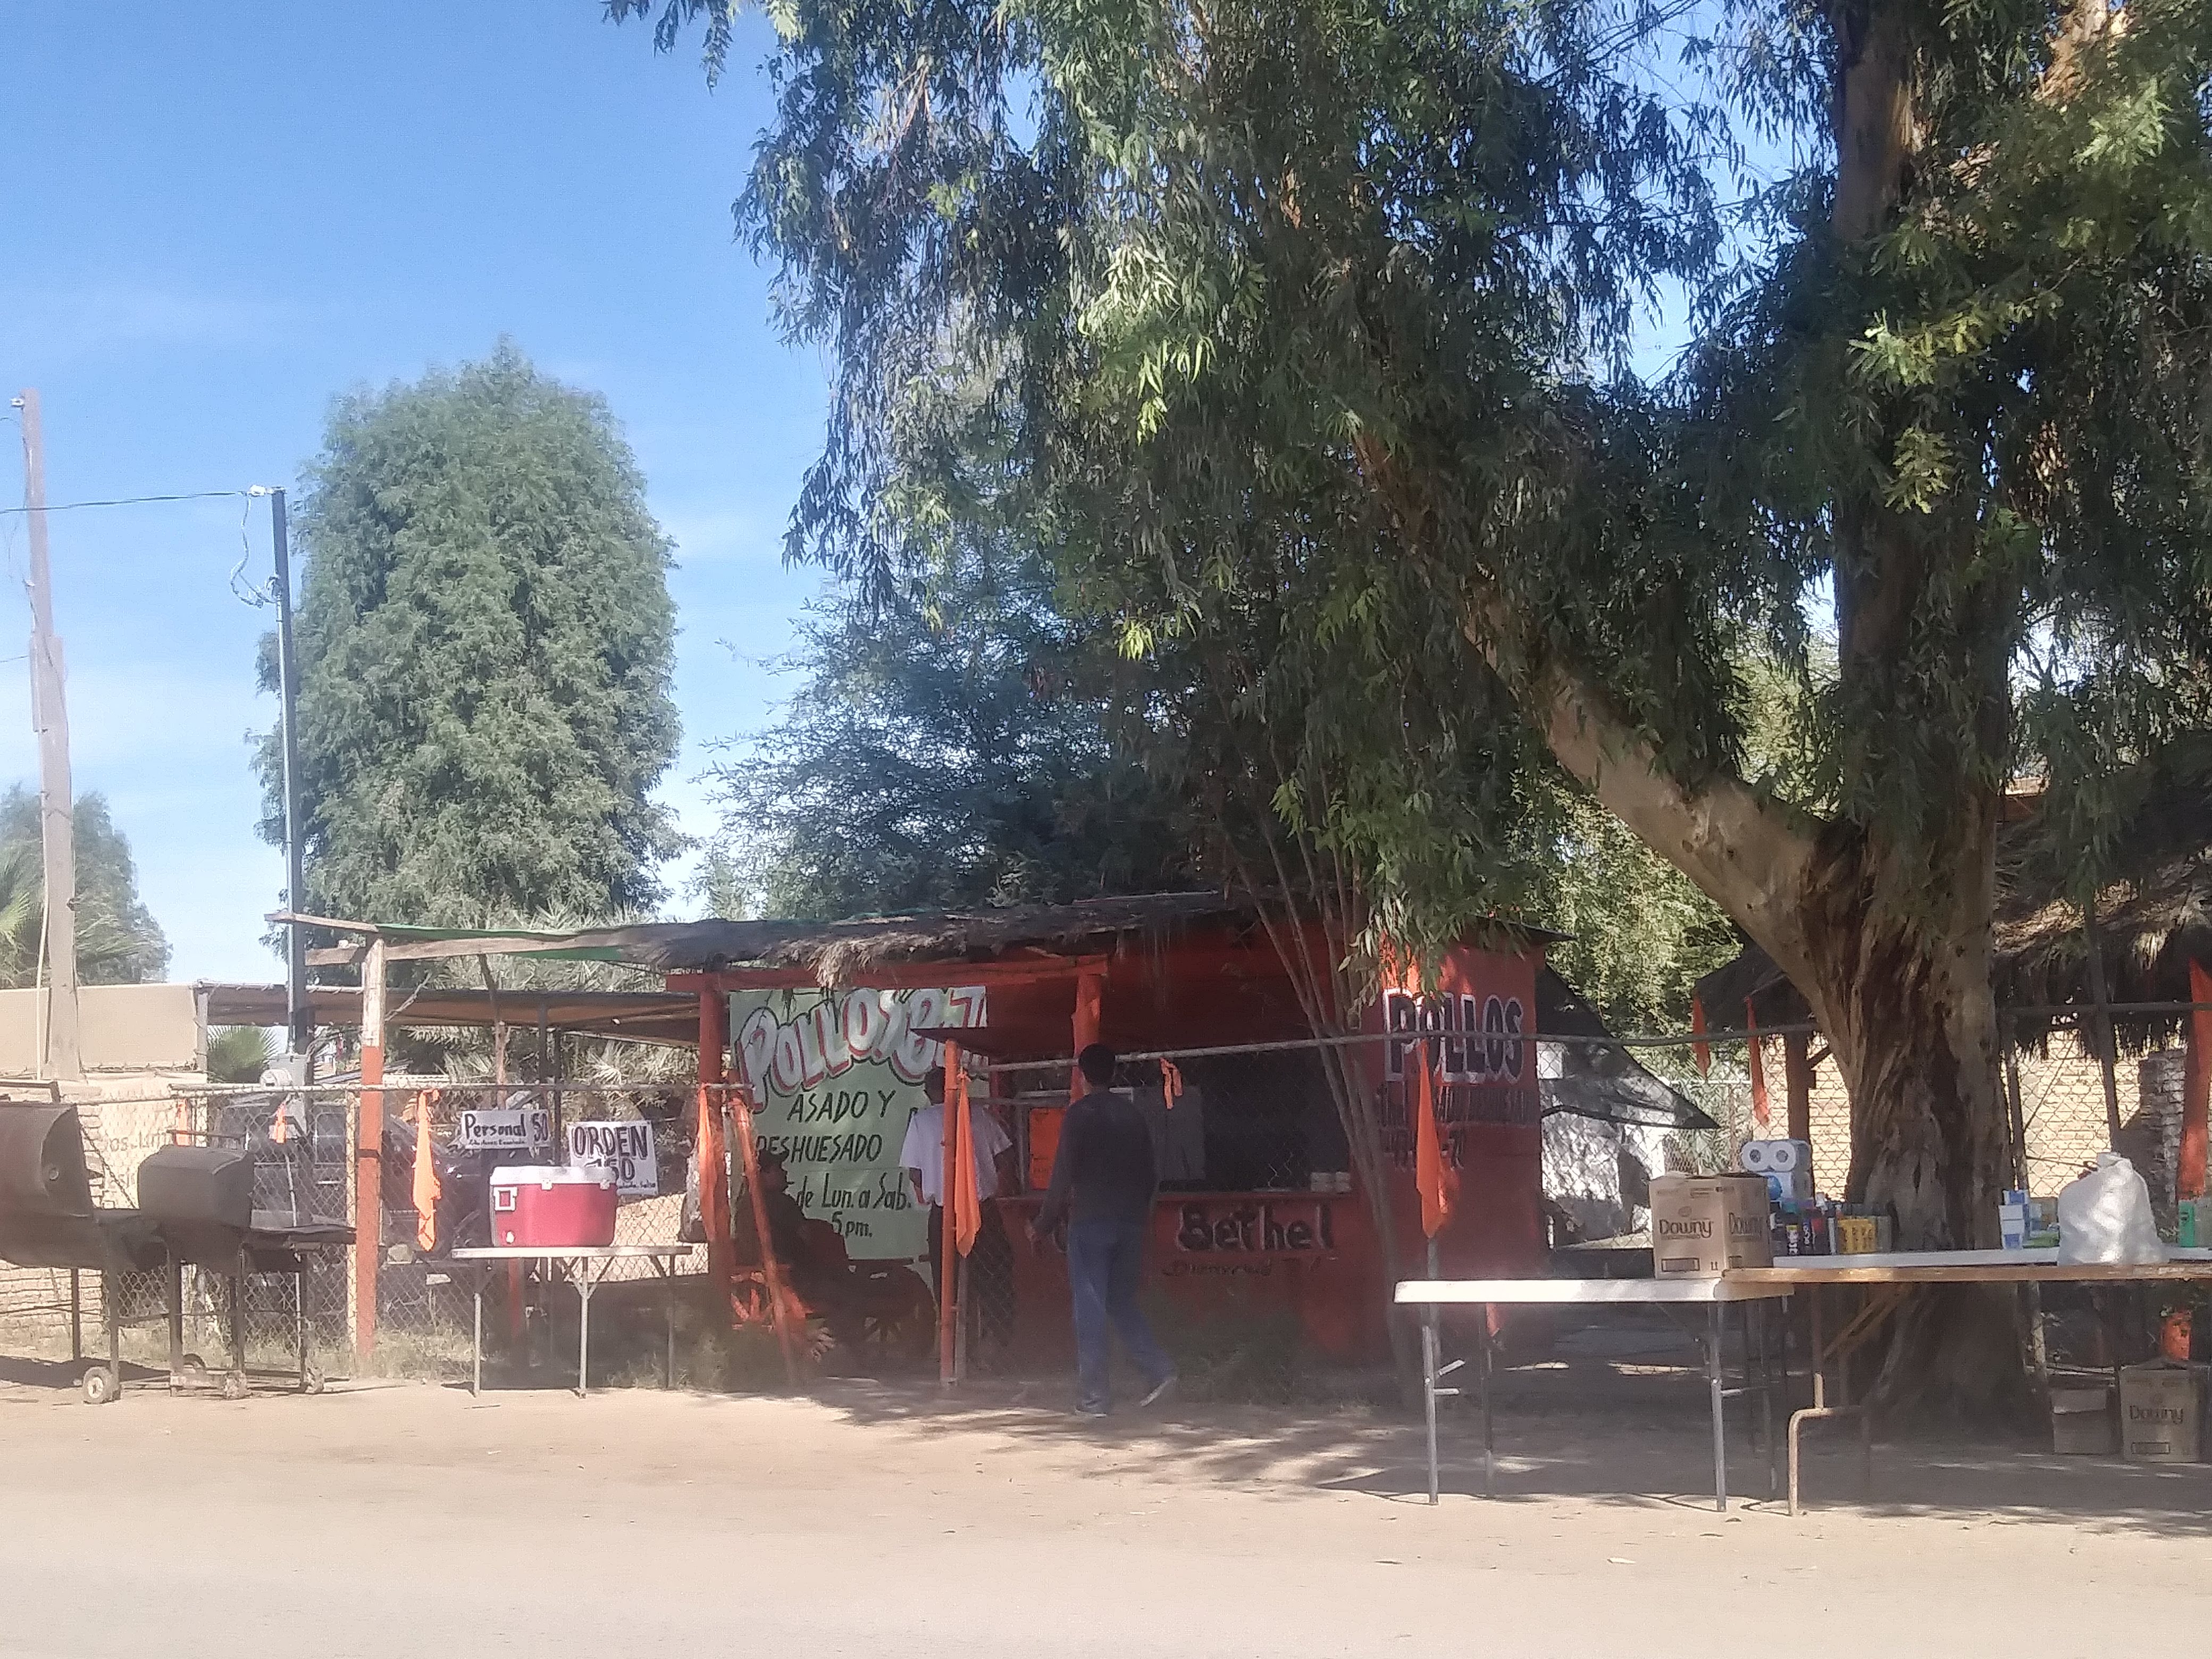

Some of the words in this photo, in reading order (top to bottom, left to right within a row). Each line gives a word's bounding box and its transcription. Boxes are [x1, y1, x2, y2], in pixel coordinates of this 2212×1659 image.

[786, 1091, 868, 1124] ASADO
[878, 1089, 896, 1119] Y
[464, 1113, 526, 1139] Personal
[572, 1126, 648, 1160] ORDEN
[797, 1175, 814, 1208] de
[858, 1191, 870, 1208] a
[873, 1171, 912, 1211] Sab.
[1175, 1201, 1335, 1252] Bethel
[1659, 1218, 1713, 1239] Downy
